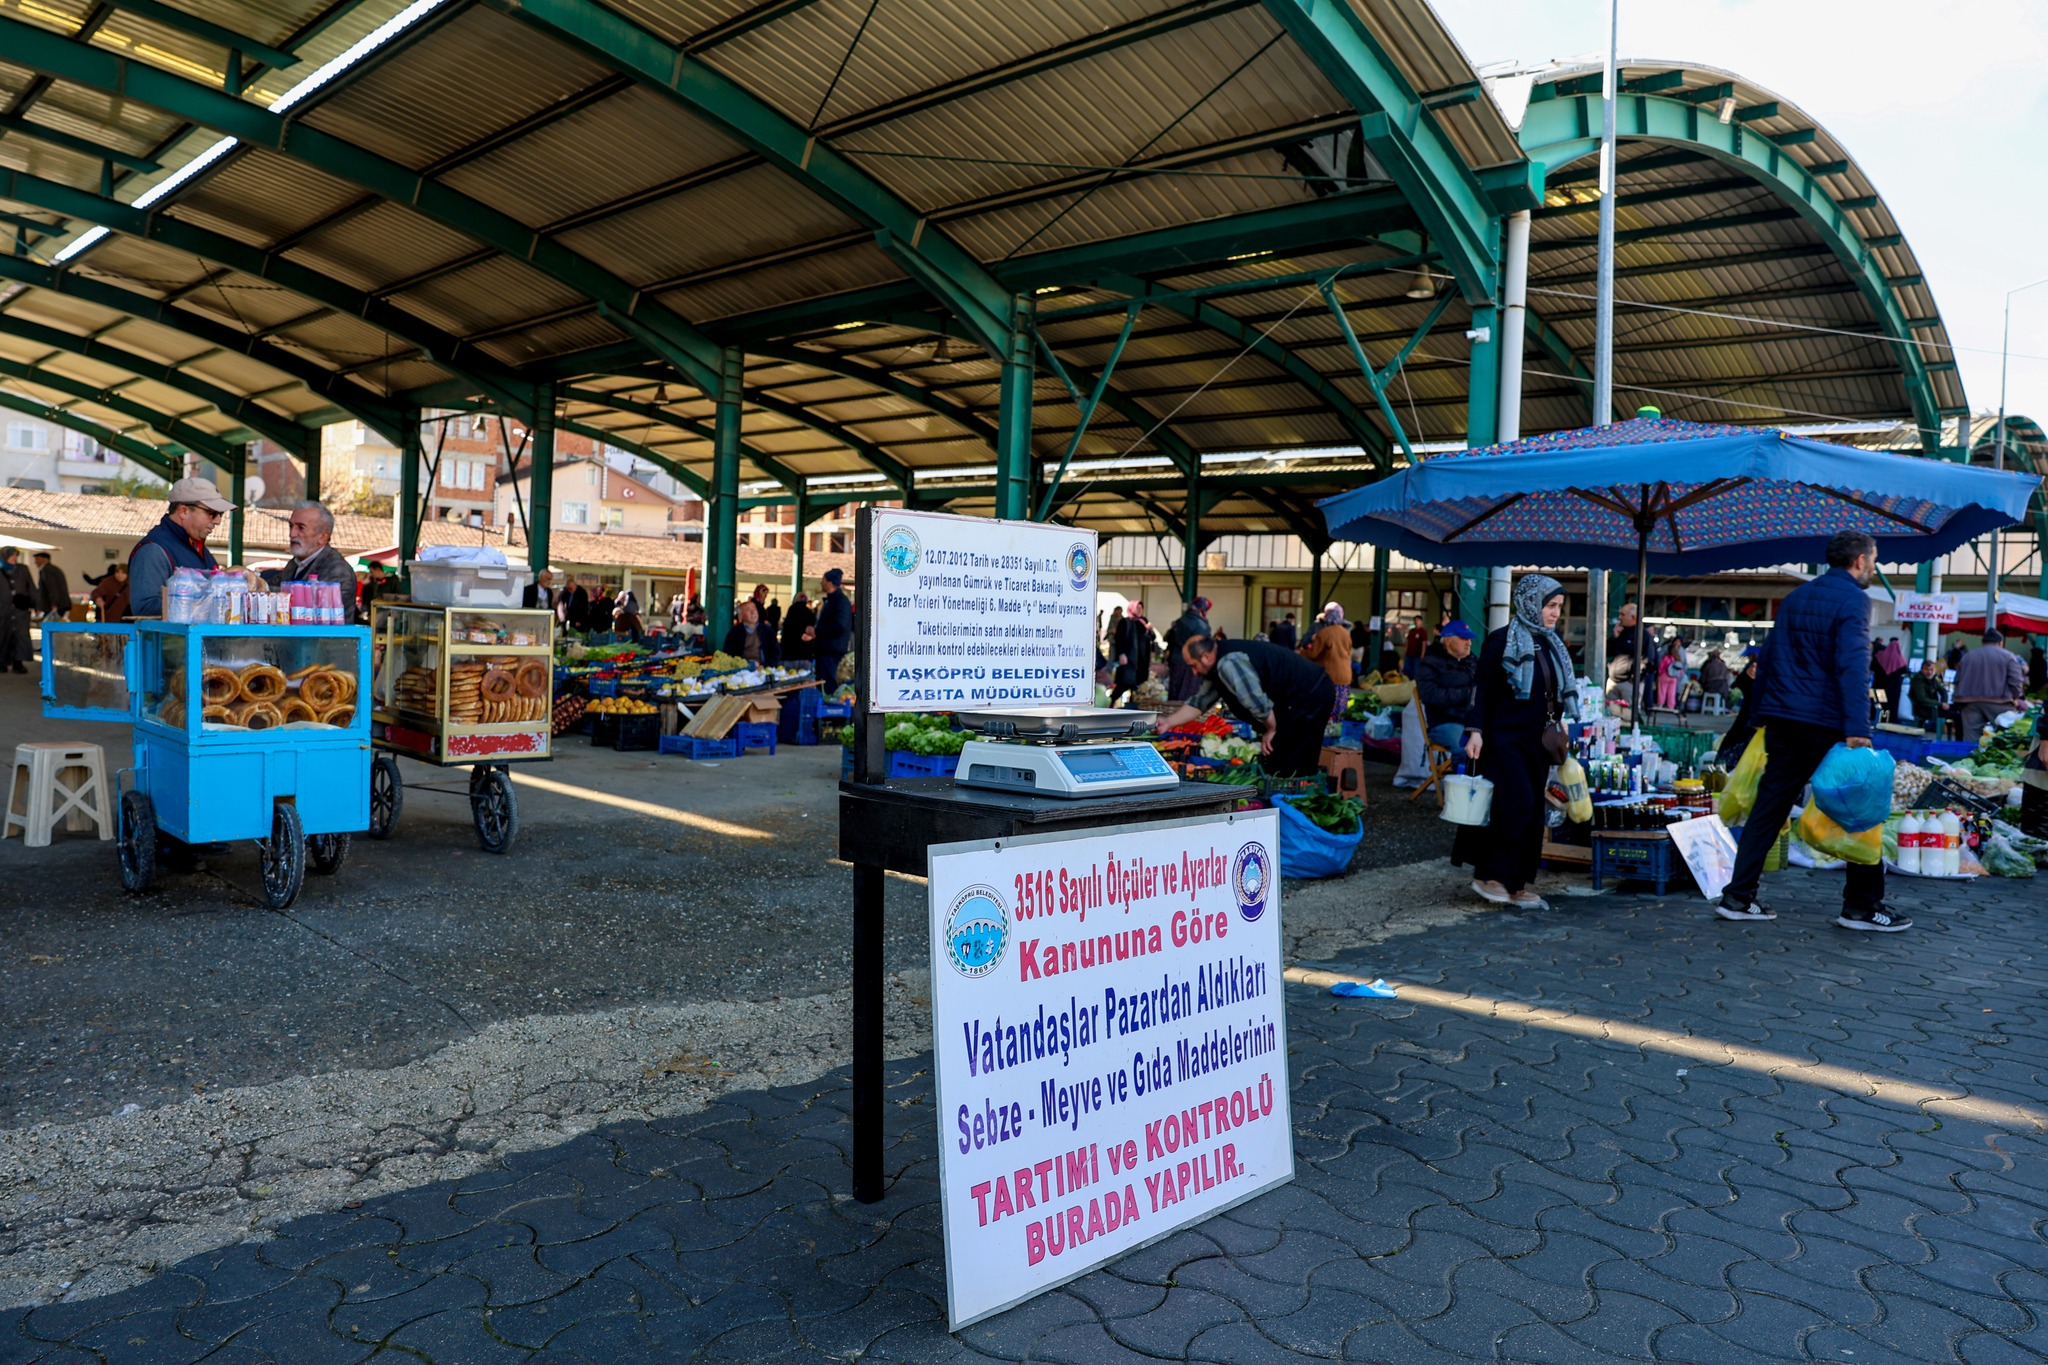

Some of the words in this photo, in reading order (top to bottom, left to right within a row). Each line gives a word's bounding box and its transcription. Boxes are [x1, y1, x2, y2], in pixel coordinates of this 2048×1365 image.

[925, 549, 968, 566] 12.07.2012
[970, 552, 989, 568] Tarih
[991, 558, 999, 568] ve
[1001, 556, 1022, 570] 28351
[1024, 557, 1044, 574] Sayılı
[919, 573, 961, 590] yayınlanan
[963, 574, 992, 590] Gümrük
[994, 580, 1002, 590] ve
[1005, 577, 1030, 592] Ticaret
[1032, 579, 1064, 597] Bakanlığı
[888, 593, 911, 608] Pazar
[913, 594, 940, 609] Yerleri
[942, 596, 988, 614] Yönetmeliği
[990, 598, 996, 612] 6.
[998, 598, 1021, 612] Madde
[1038, 600, 1058, 614] bendi
[1058, 603, 1087, 618] uyarınca
[1898, 612, 1954, 620] KESTANE
[1909, 604, 1943, 612] KUZU
[918, 621, 982, 636] Tüketicilerimizin
[984, 624, 1002, 637] satın
[1004, 624, 1034, 638] aldıkları
[1036, 625, 1063, 638] malların
[888, 641, 936, 659] ağırlıklarını
[938, 642, 965, 656] kontrol
[967, 642, 1020, 656] edebilecekleri
[1020, 643, 1056, 657] elektronik
[887, 666, 986, 683] TAŞKÖPRÜ
[992, 666, 1085, 680] BELEDİYESİ
[898, 688, 965, 701] ZABITA
[971, 685, 1076, 700] MÜDÜRLÜĞÜ
[1014, 868, 1055, 922] 3516
[1059, 864, 1102, 922] Sayılı
[1106, 851, 1158, 914] Ölçüler
[1162, 862, 1178, 895] ve
[1180, 846, 1228, 902] Ayarlar
[1018, 925, 1162, 982] Kanununa
[1171, 908, 1228, 948] Göre
[969, 964, 988, 974] 1869
[964, 996, 1099, 1078] Vatandaşlar
[1105, 974, 1192, 1040] Pazardan
[1198, 955, 1266, 1014] Aldıkları
[958, 1098, 1022, 1155] Sebze
[1040, 1075, 1101, 1131] Meyve
[1107, 1068, 1128, 1105] ve
[1133, 1046, 1172, 1096] Gıda
[1177, 1014, 1276, 1082] Maddelerinin
[970, 1143, 1100, 1228] TARTIMI
[1106, 1139, 1138, 1176] ve
[1144, 1073, 1274, 1162] KONTROLÜ
[1026, 1184, 1140, 1267] BURADA
[1144, 1142, 1245, 1213] YAPILIR.
